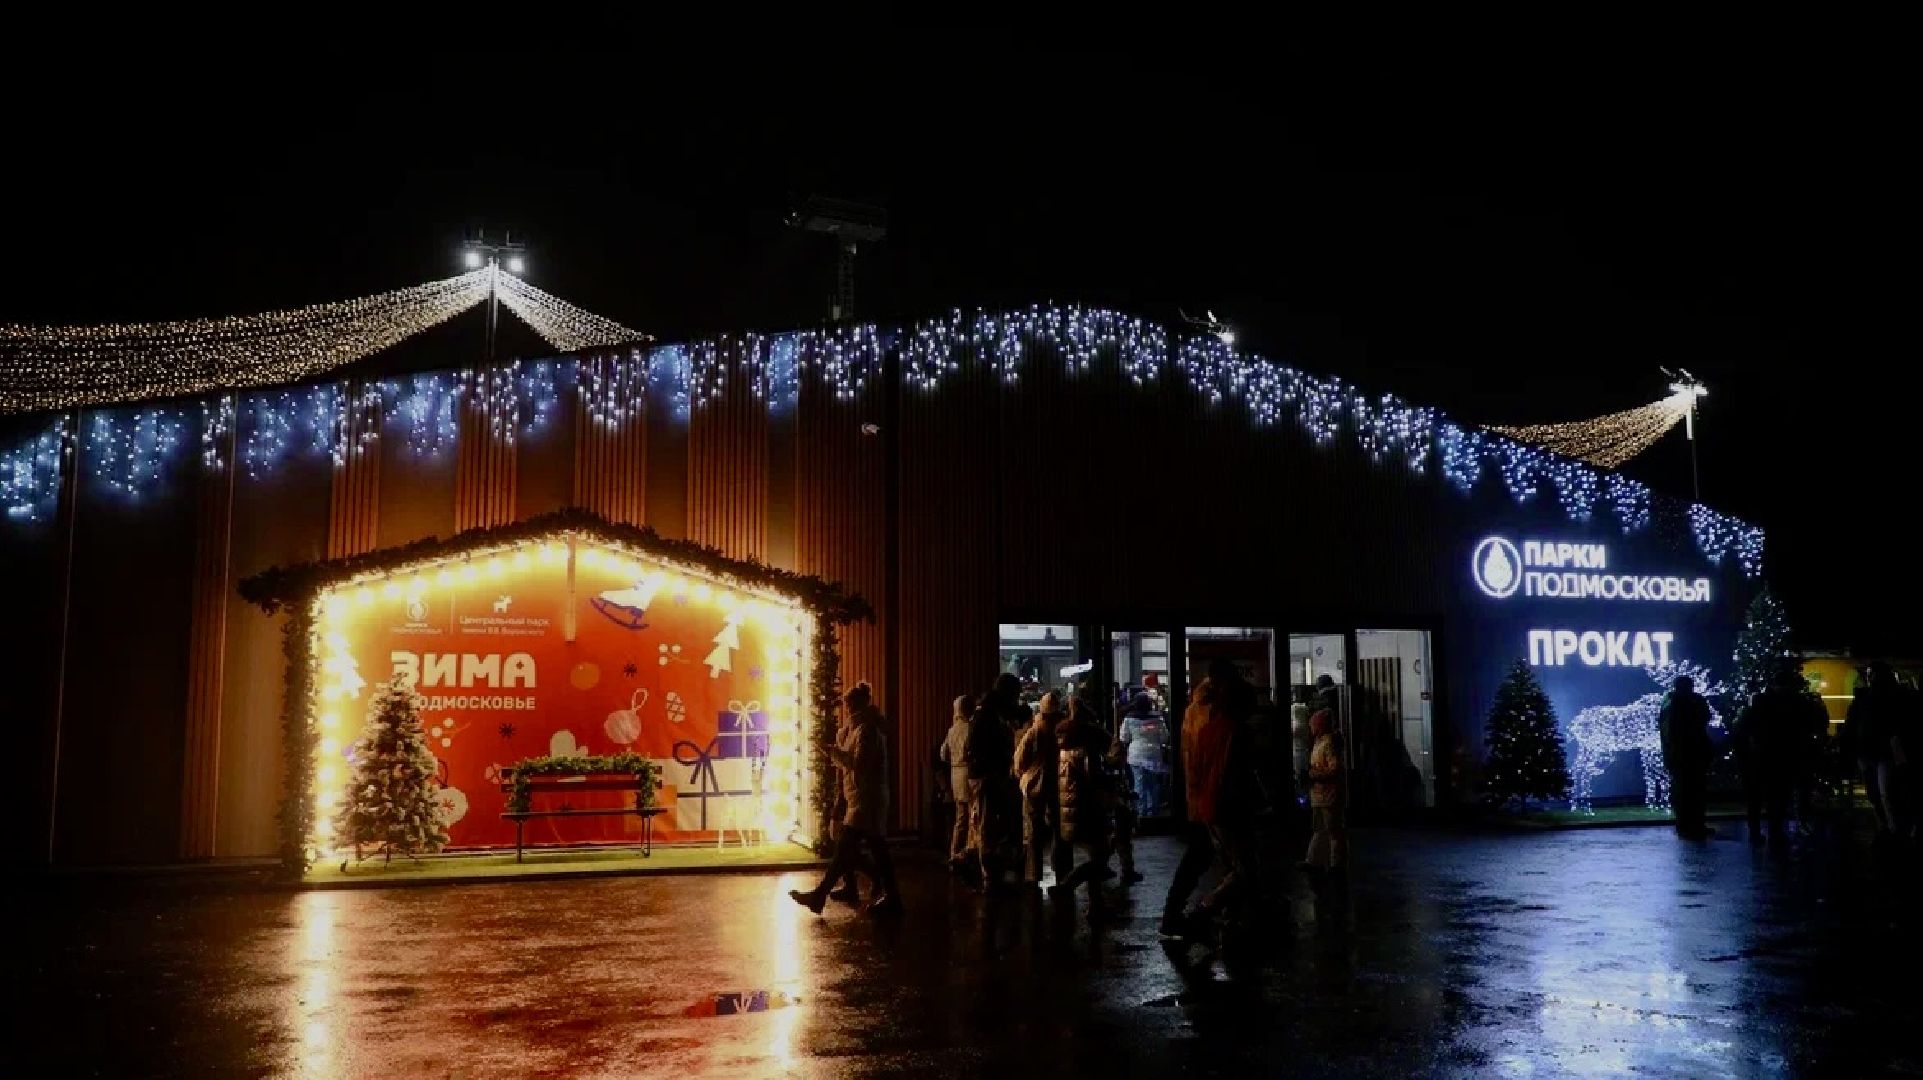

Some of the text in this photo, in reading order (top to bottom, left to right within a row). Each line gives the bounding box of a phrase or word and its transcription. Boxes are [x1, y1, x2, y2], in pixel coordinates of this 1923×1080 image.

[1524, 541, 1606, 569] ПАРКИ
[1525, 571, 1711, 602] ПОДМОСКОВЬЯ
[1528, 629, 1675, 667] ПРОКАТ
[390, 651, 537, 688] ЗИМА
[412, 695, 537, 711] ОДМОСКОВЬЕ
